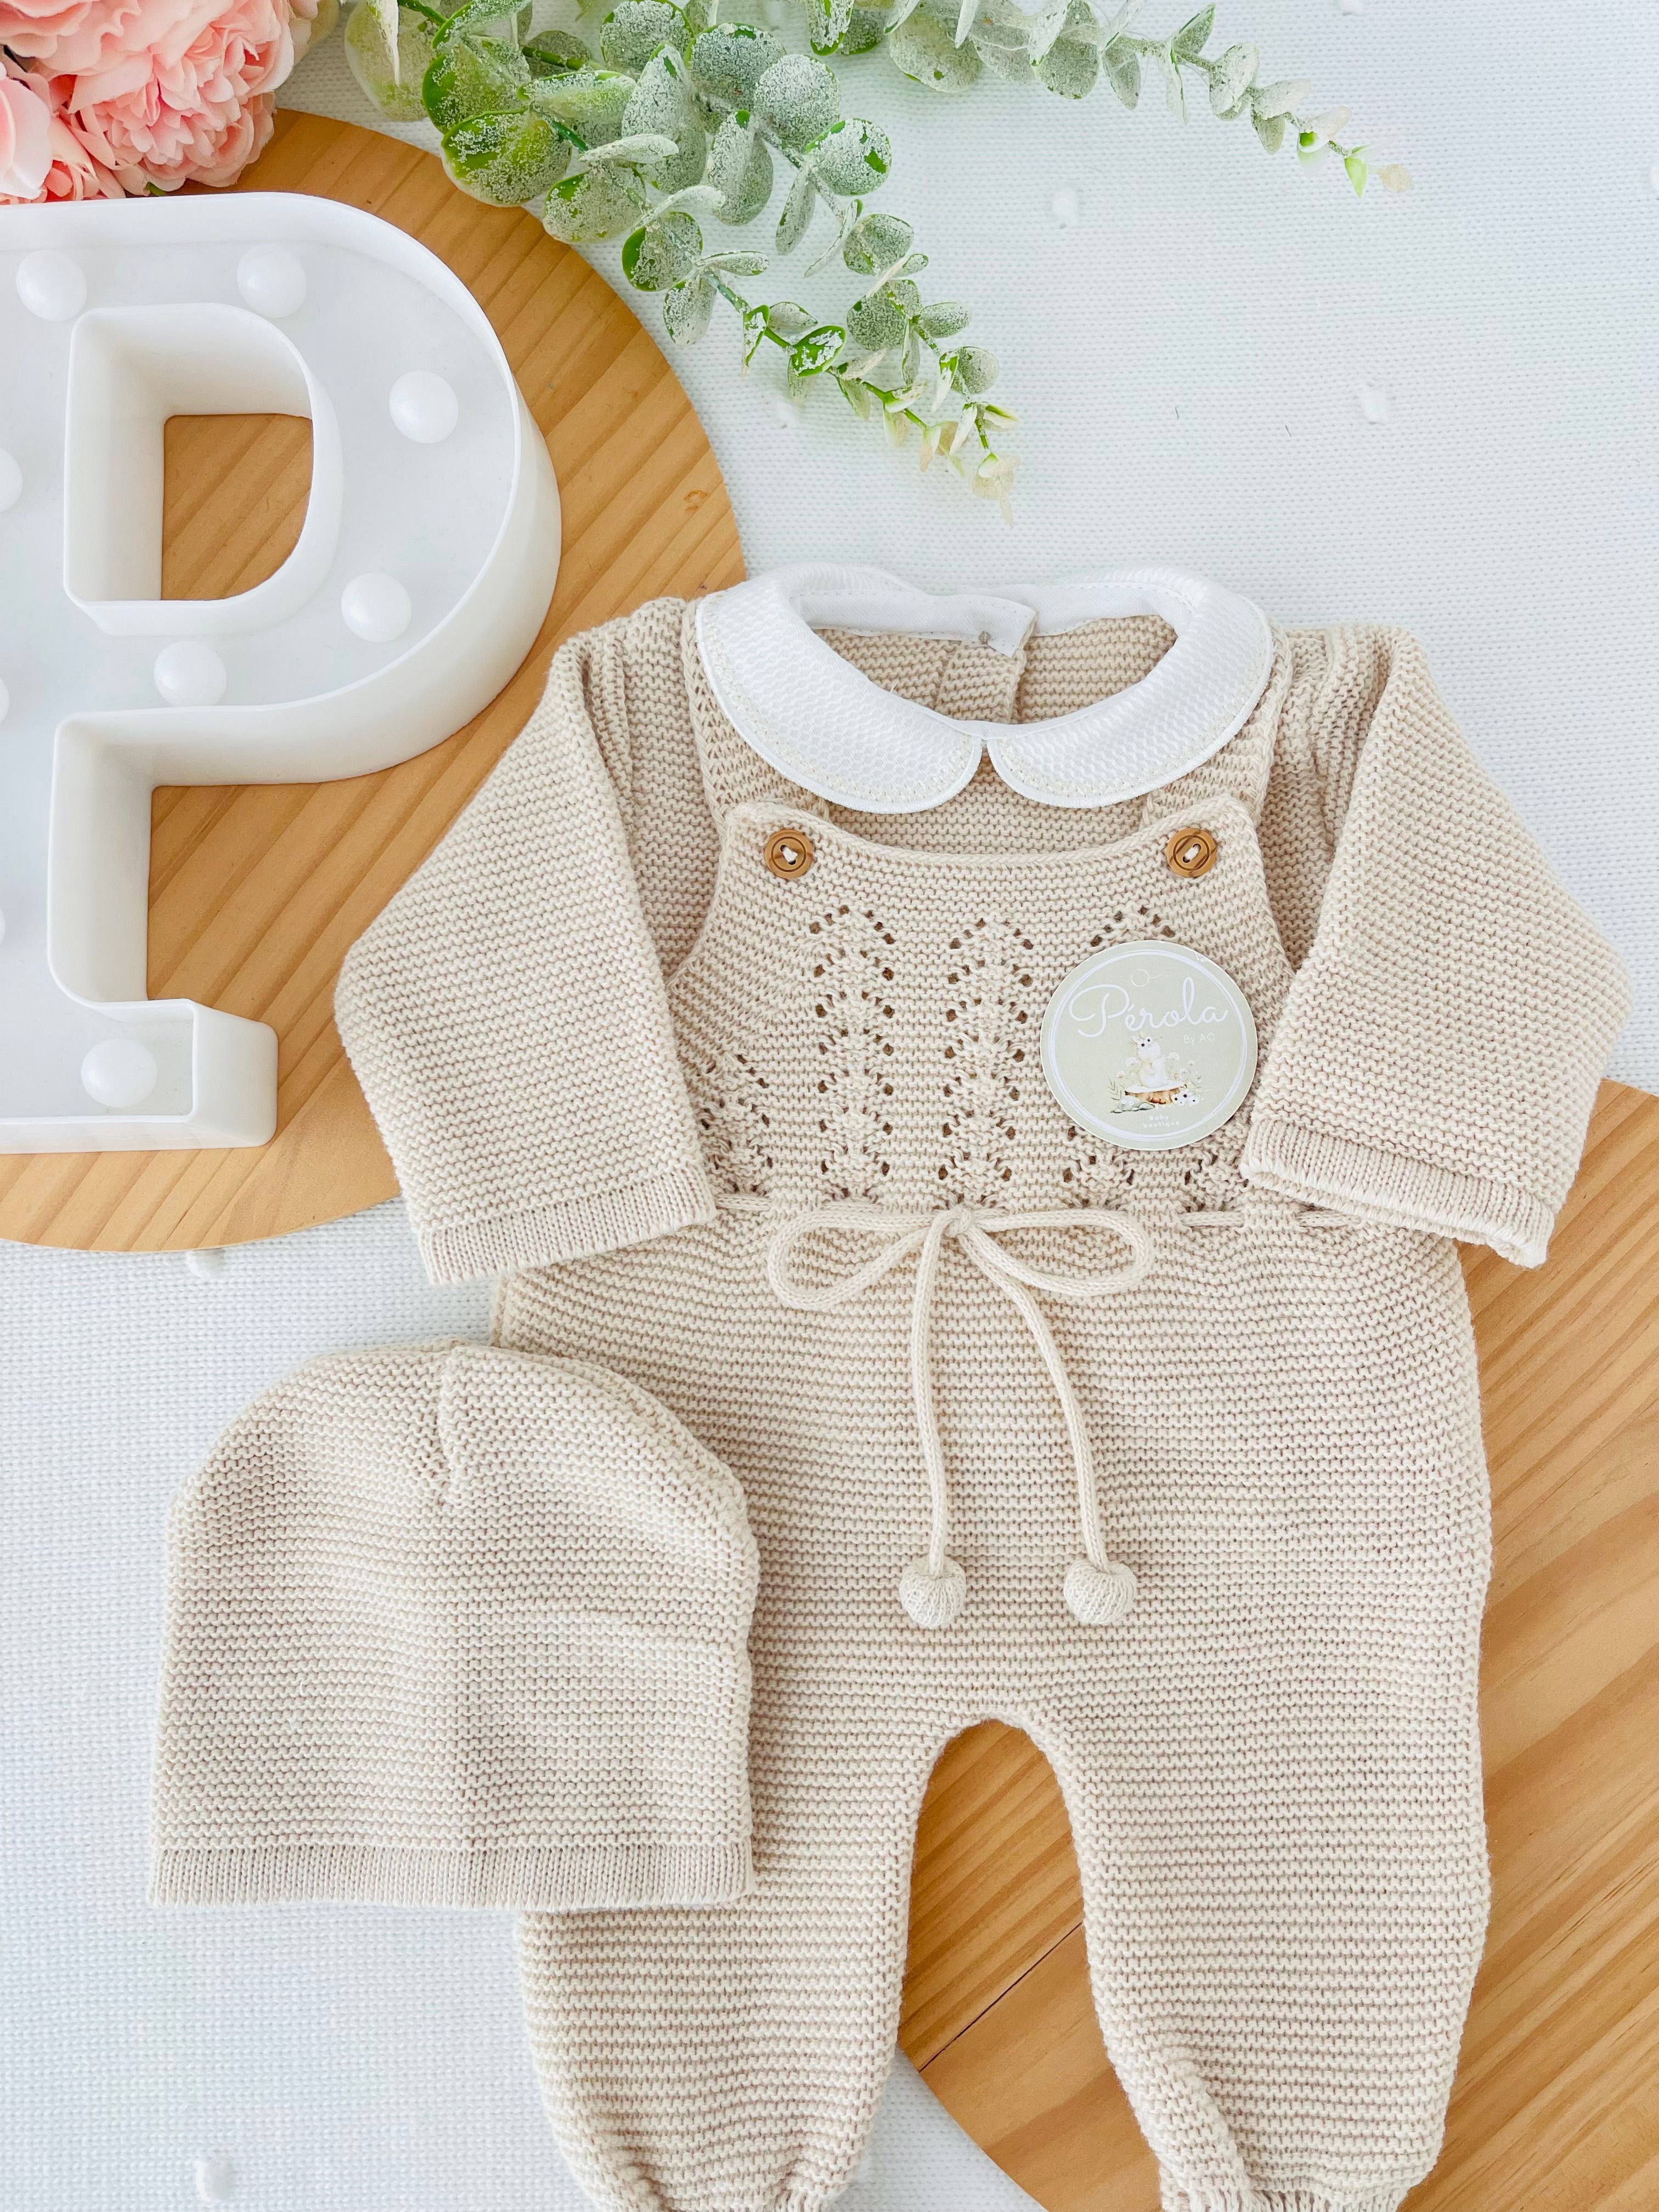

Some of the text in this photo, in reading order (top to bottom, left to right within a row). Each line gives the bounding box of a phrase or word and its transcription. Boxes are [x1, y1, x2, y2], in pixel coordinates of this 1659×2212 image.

[1069, 977, 1228, 1038] Pérola
[1184, 1032, 1216, 1045] By AC
